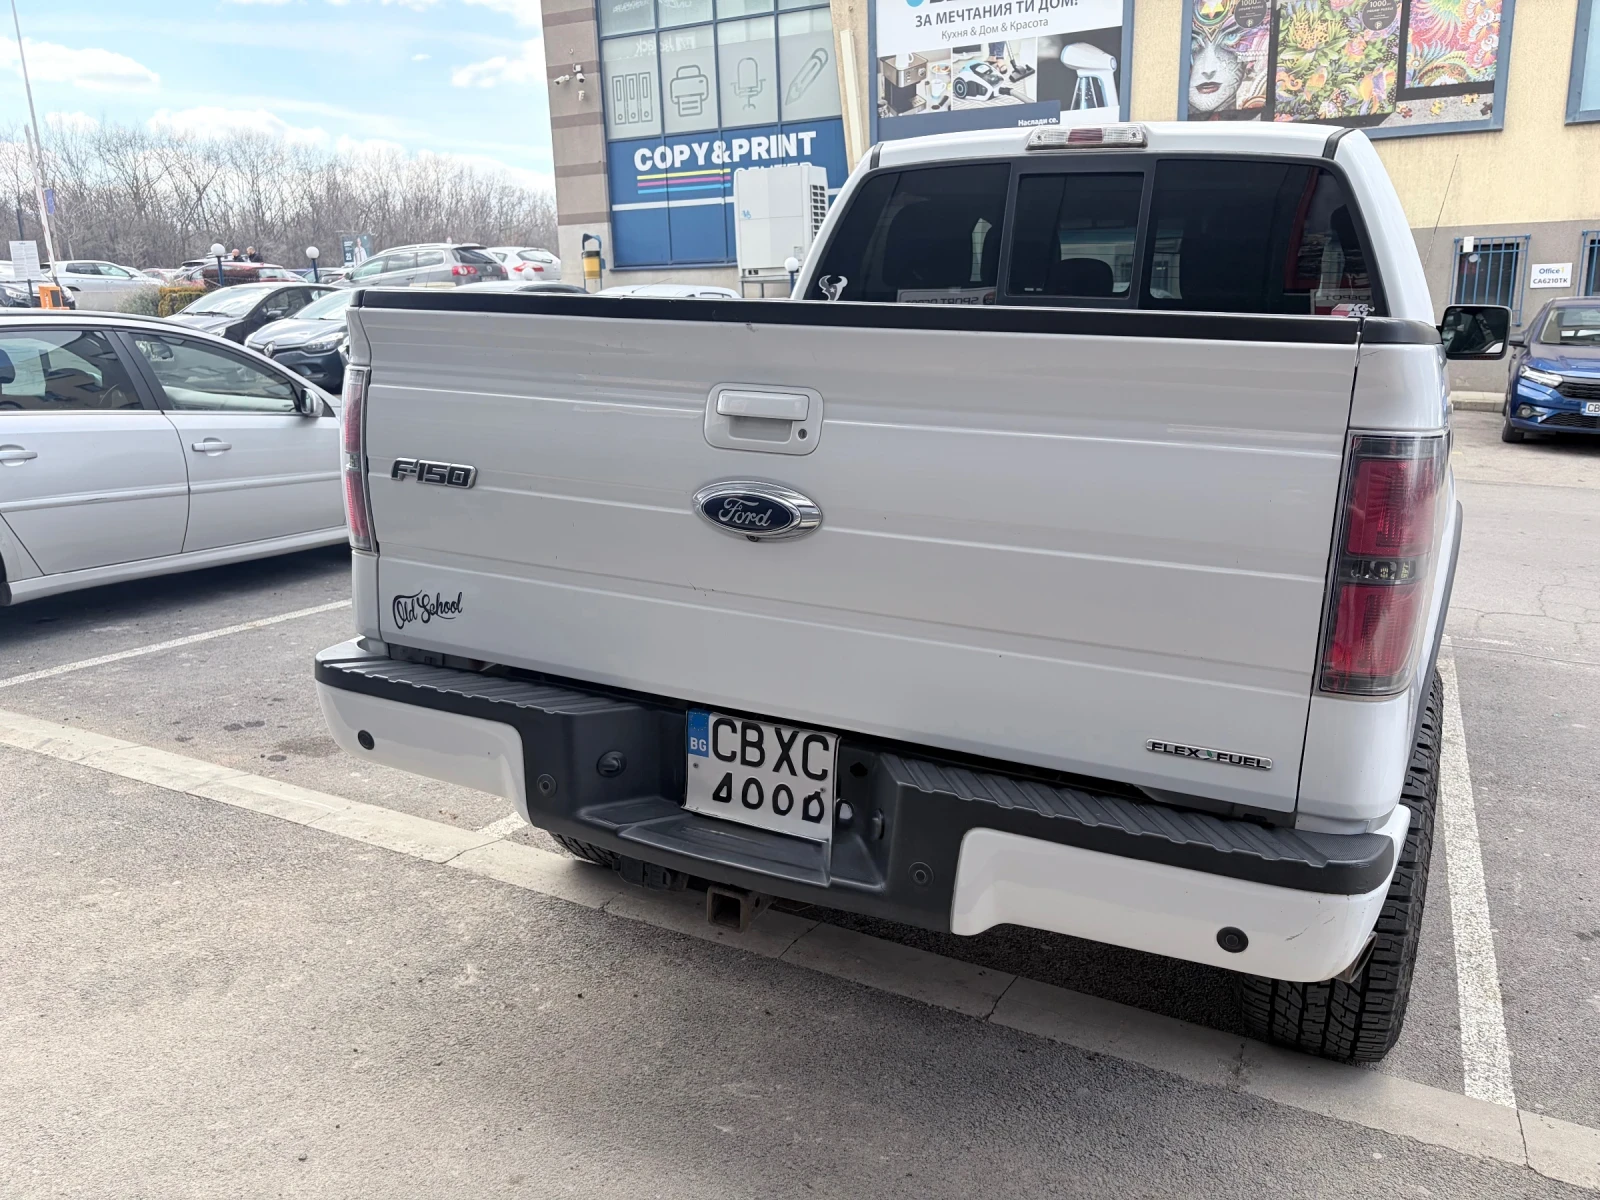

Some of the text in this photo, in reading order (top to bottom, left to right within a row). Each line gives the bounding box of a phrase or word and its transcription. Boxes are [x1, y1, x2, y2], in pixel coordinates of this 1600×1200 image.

[915, 14, 932, 28] ЗА
[936, 2, 1012, 25] МЕЧТАНИЯ
[1016, 0, 1035, 14] ТИ
[1370, 0, 1387, 8] 1000
[941, 19, 1049, 42] Кухня & Дом & Красота
[1018, 119, 1048, 127] Наслади
[634, 131, 817, 172] COPY&PRINT
[391, 457, 478, 489] F-150
[718, 497, 773, 527] Ford
[392, 589, 463, 630] Old School
[690, 736, 707, 752] BG
[1151, 741, 1268, 769] FLEX FUEL
